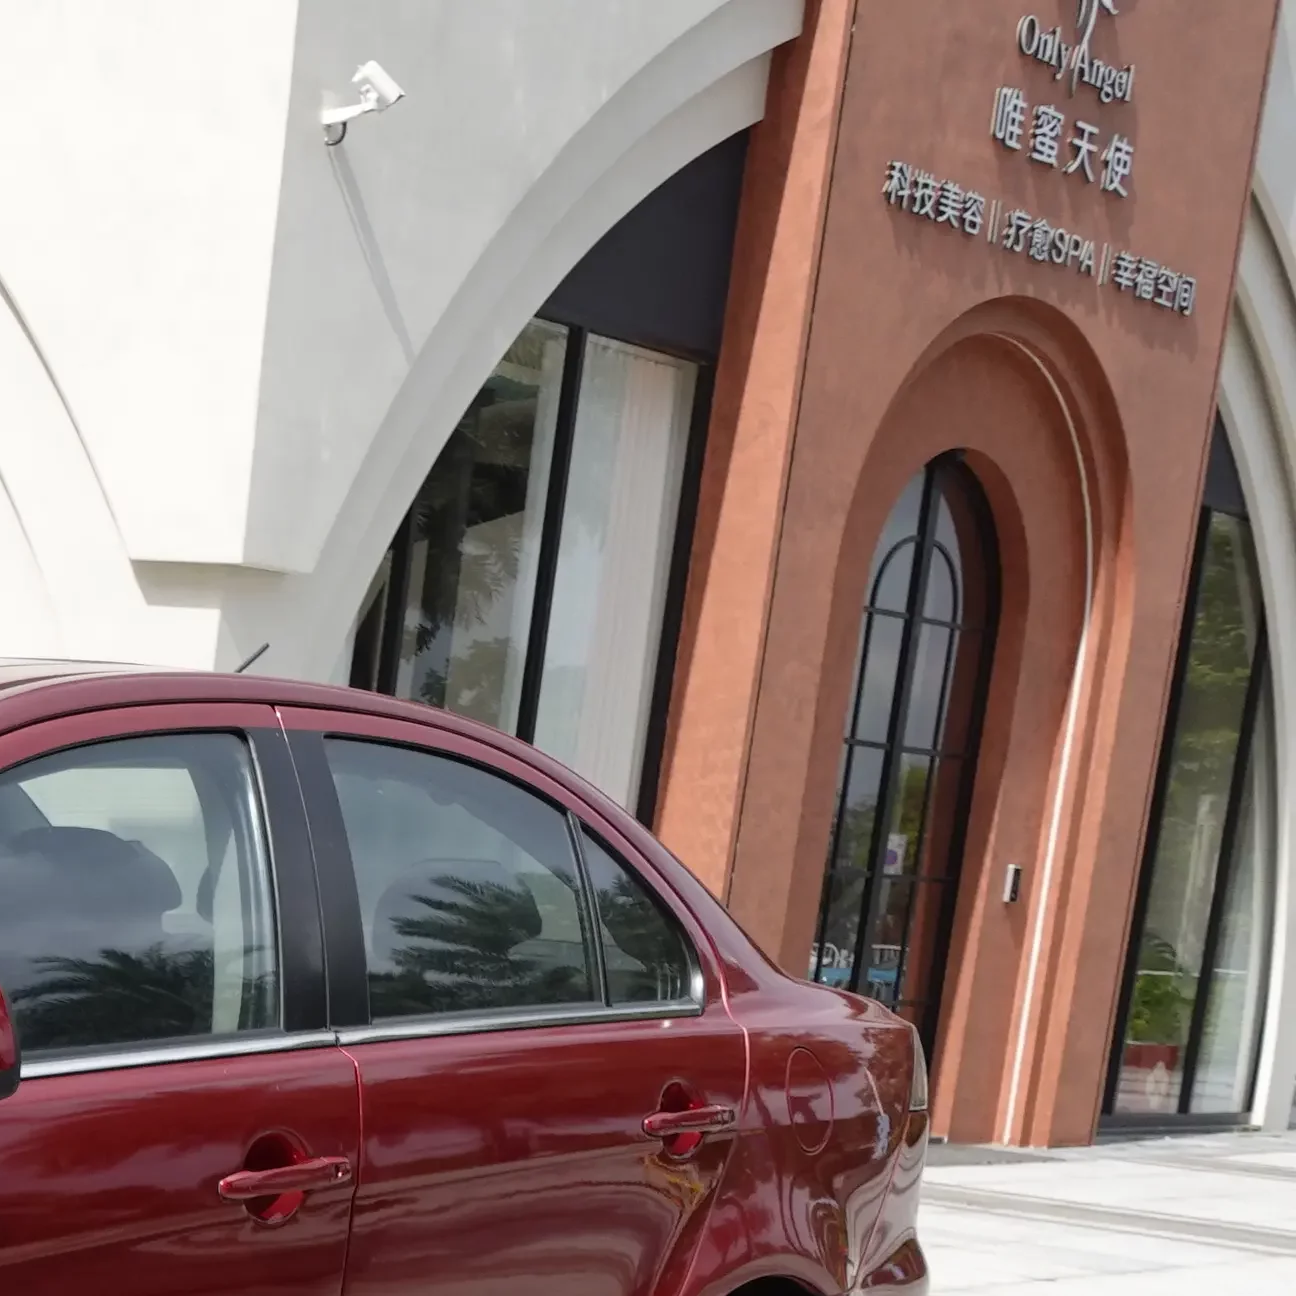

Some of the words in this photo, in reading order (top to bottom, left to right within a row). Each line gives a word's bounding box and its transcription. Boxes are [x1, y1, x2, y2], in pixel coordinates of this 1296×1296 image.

[1016, 14, 1072, 80] Only
[1072, 42, 1135, 103] Angel
[991, 86, 1134, 198] 唯蜜天使
[883, 160, 987, 235] 科技美容
[1003, 208, 1095, 277] 疗愈SPA
[1111, 250, 1197, 316] 幸福空间
